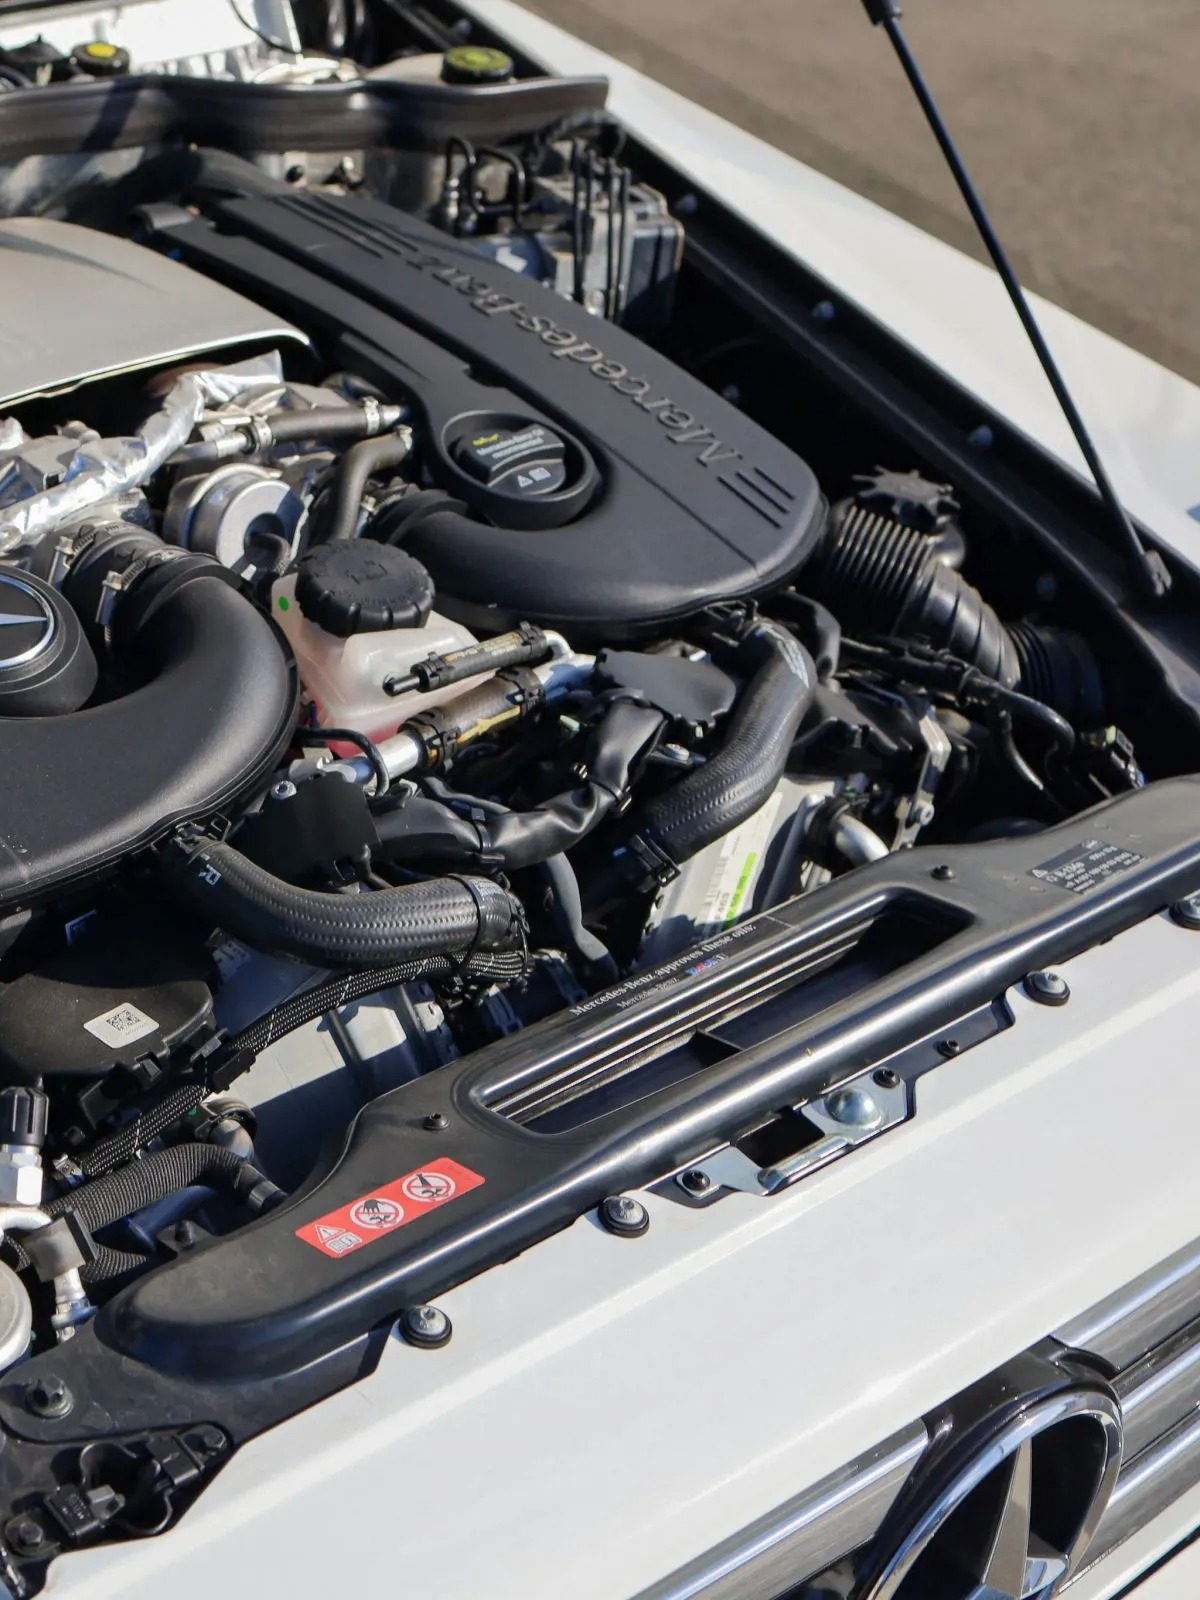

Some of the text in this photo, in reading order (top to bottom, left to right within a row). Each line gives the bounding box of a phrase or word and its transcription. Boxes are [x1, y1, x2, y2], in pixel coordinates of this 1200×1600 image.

[407, 256, 742, 468] Mercedes-Benz
[569, 975, 656, 1016] Mercedes-Benz
[655, 950, 704, 980] approves
[702, 935, 734, 953] these
